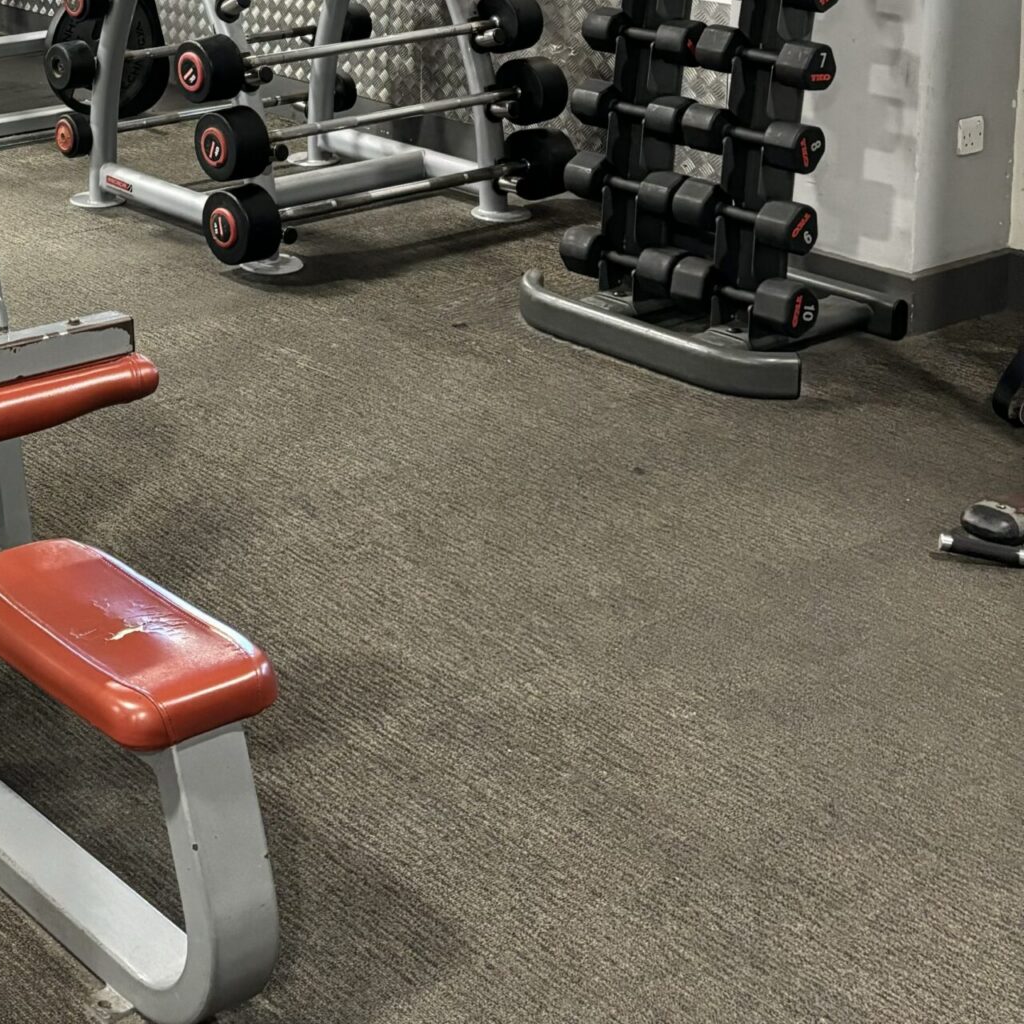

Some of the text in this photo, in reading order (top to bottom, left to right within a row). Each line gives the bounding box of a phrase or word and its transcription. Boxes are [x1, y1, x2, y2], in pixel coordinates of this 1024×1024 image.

[820, 52, 827, 68] 7
[810, 140, 822, 152] 8
[802, 304, 815, 322] 10
